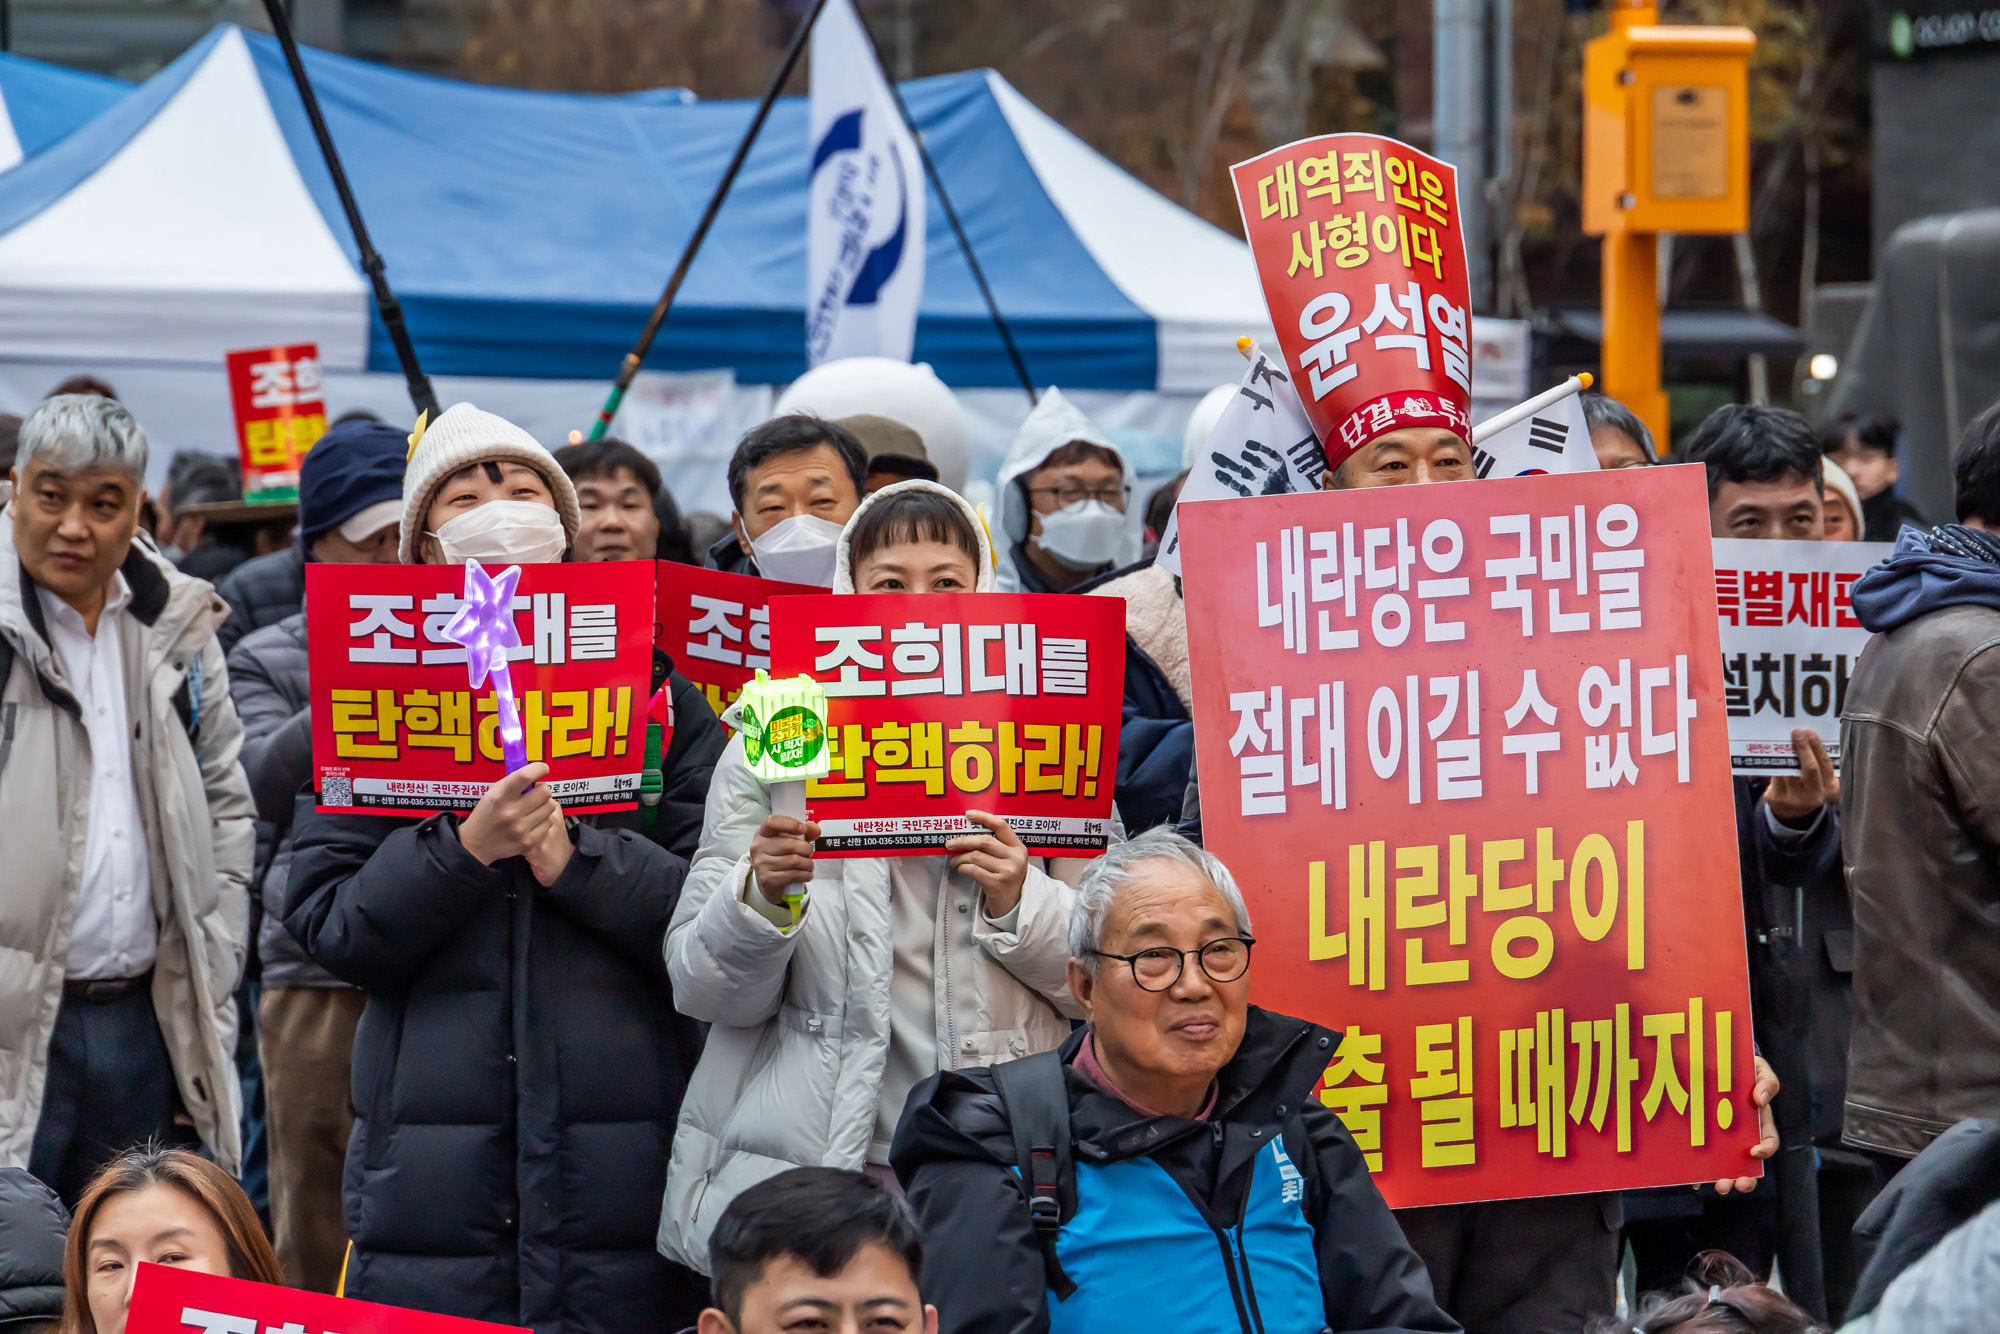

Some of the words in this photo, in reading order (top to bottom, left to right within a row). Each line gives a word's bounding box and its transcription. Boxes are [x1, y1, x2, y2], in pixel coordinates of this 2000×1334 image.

[1257, 149, 1448, 227] 대역죄인은
[1286, 211, 1443, 280] 사형이다
[1298, 281, 1470, 402] 윤석열
[1339, 397, 1396, 449] 단결
[1256, 518, 1470, 654] 내란당은
[1485, 503, 1645, 637] 국민을
[814, 622, 1089, 696] 조희대를
[1722, 652, 1861, 718] 설치하
[331, 686, 631, 762] 탄핵하라!
[771, 714, 802, 731] 미국산
[771, 726, 802, 744] 소고기
[771, 743, 782, 755] 사
[1229, 681, 1347, 816] 절대
[1367, 670, 1482, 804] 이길
[1502, 669, 1561, 795] 수
[1578, 654, 1697, 789] 없다
[386, 782, 429, 793] 내란청산!
[562, 781, 590, 793] 모이자!
[806, 721, 1102, 798] 탄핵하라!
[362, 796, 376, 804] 후원
[381, 797, 395, 805] 신한
[396, 798, 451, 807] 100-036-551308
[853, 820, 898, 833] 내란청산!
[901, 817, 968, 831] 국민주권실현!
[1034, 820, 1061, 831] 모이자!
[825, 838, 841, 847] 후원
[846, 837, 862, 846] 신한
[863, 836, 922, 846] 100-036-551308
[1309, 820, 1645, 991] 내란당이
[1310, 1025, 1388, 1173] 출
[1410, 1016, 1476, 1168] 될
[1500, 997, 1734, 1158] 때까지!
